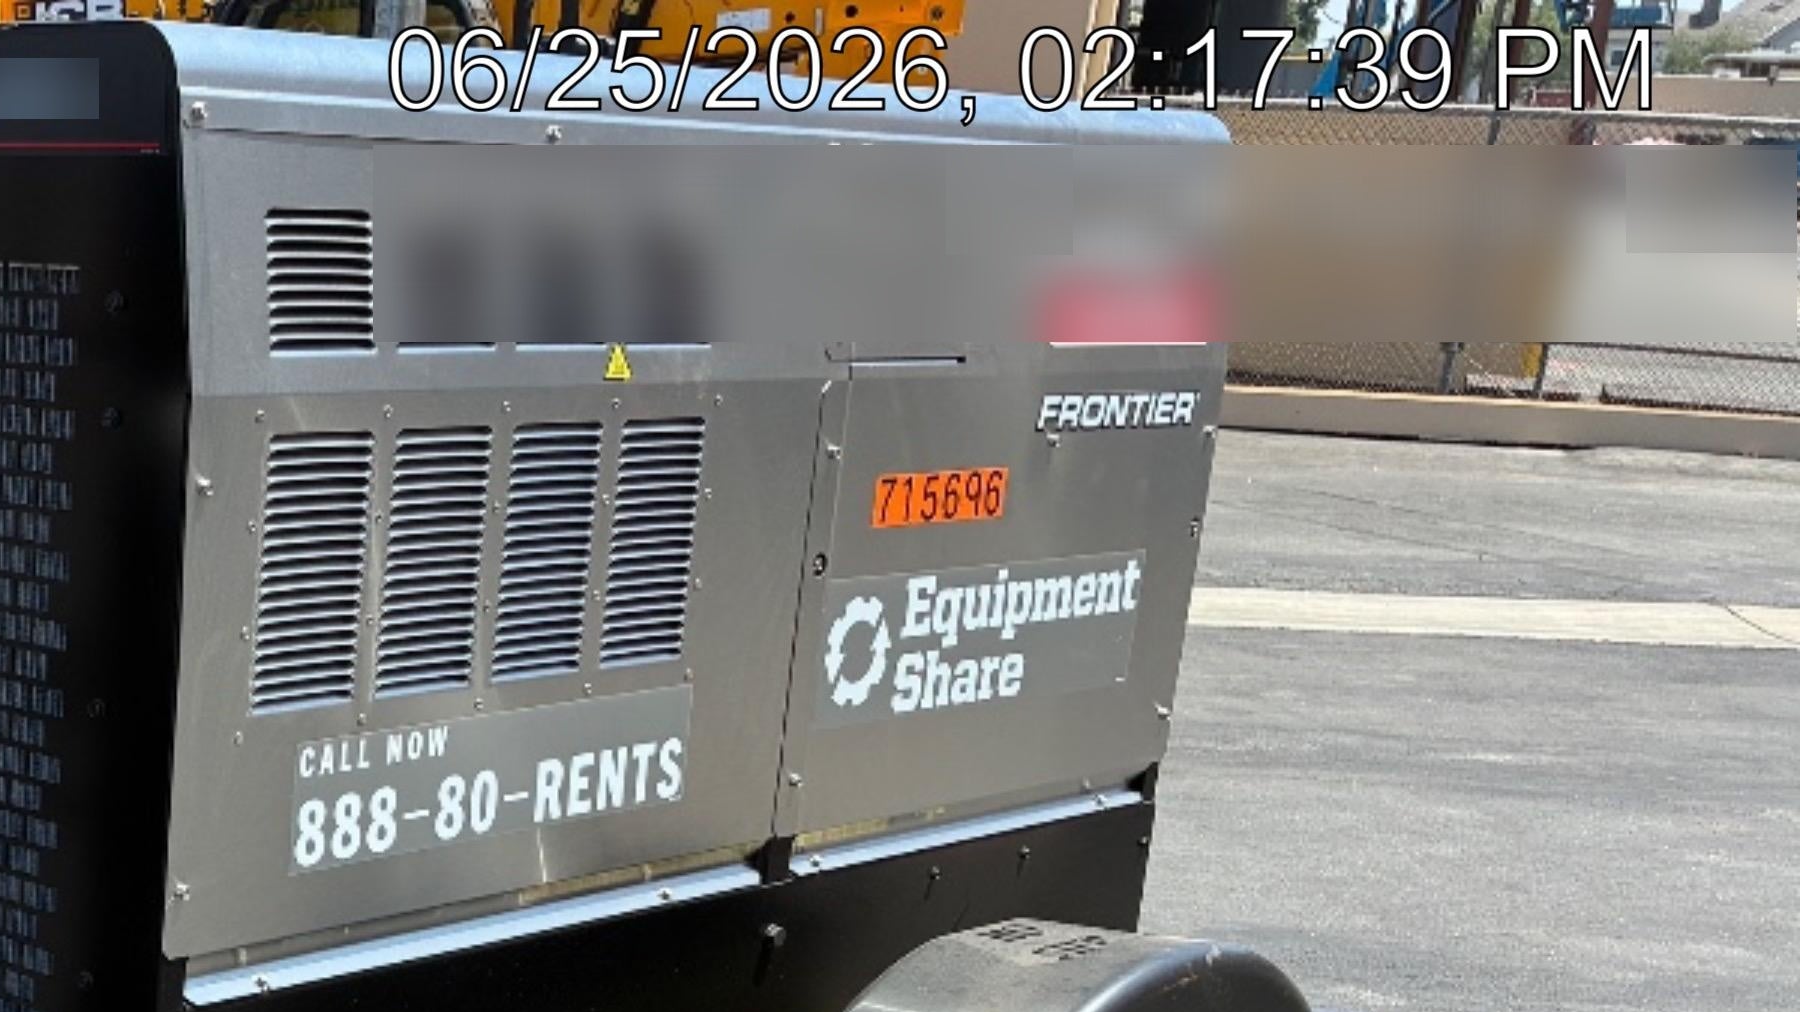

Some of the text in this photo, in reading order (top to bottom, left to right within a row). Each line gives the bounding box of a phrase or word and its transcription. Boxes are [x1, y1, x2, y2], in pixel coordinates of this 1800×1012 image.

[1036, 391, 1196, 431] FRONTIER
[878, 469, 1004, 524] 715696
[900, 559, 1142, 647] Equipment
[891, 650, 1025, 714] Share
[299, 726, 449, 778] CALL NOW
[293, 737, 684, 868] 888-80-RENTS
